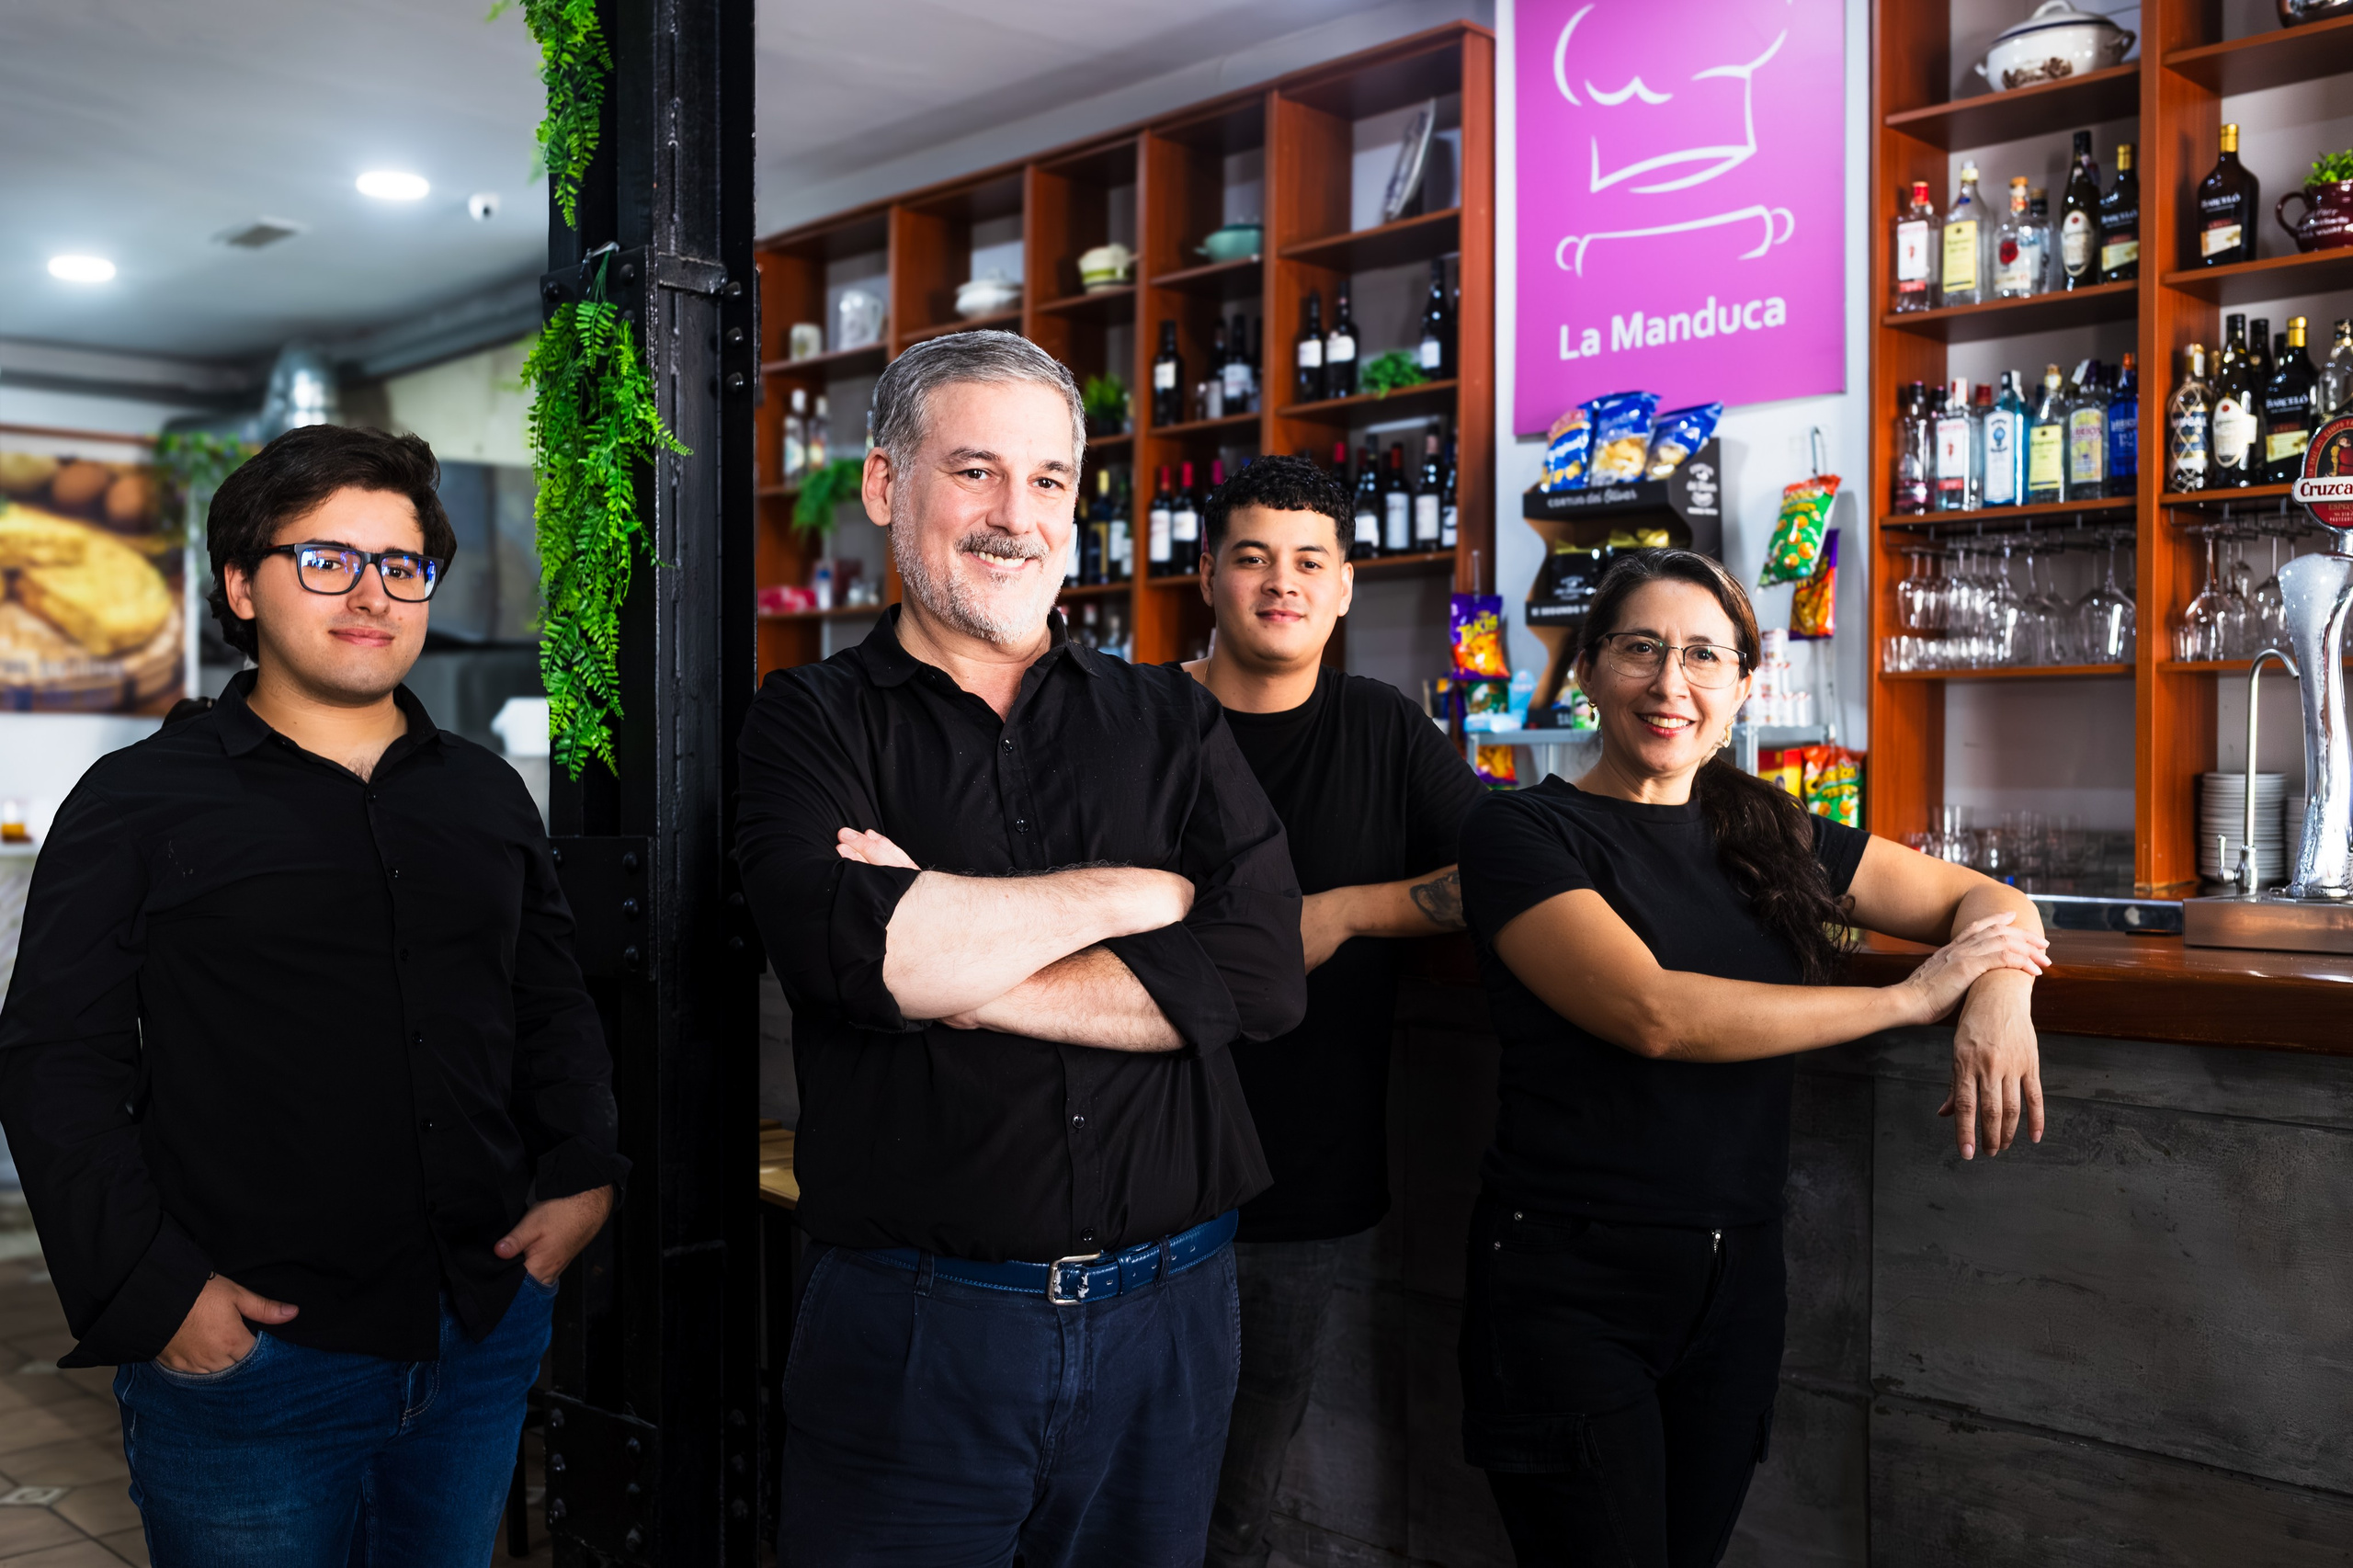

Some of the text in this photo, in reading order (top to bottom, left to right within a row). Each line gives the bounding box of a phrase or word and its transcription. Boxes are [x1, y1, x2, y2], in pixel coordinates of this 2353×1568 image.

[1560, 296, 1787, 360] La Manduca
[2300, 481, 2353, 497] Cruzca
